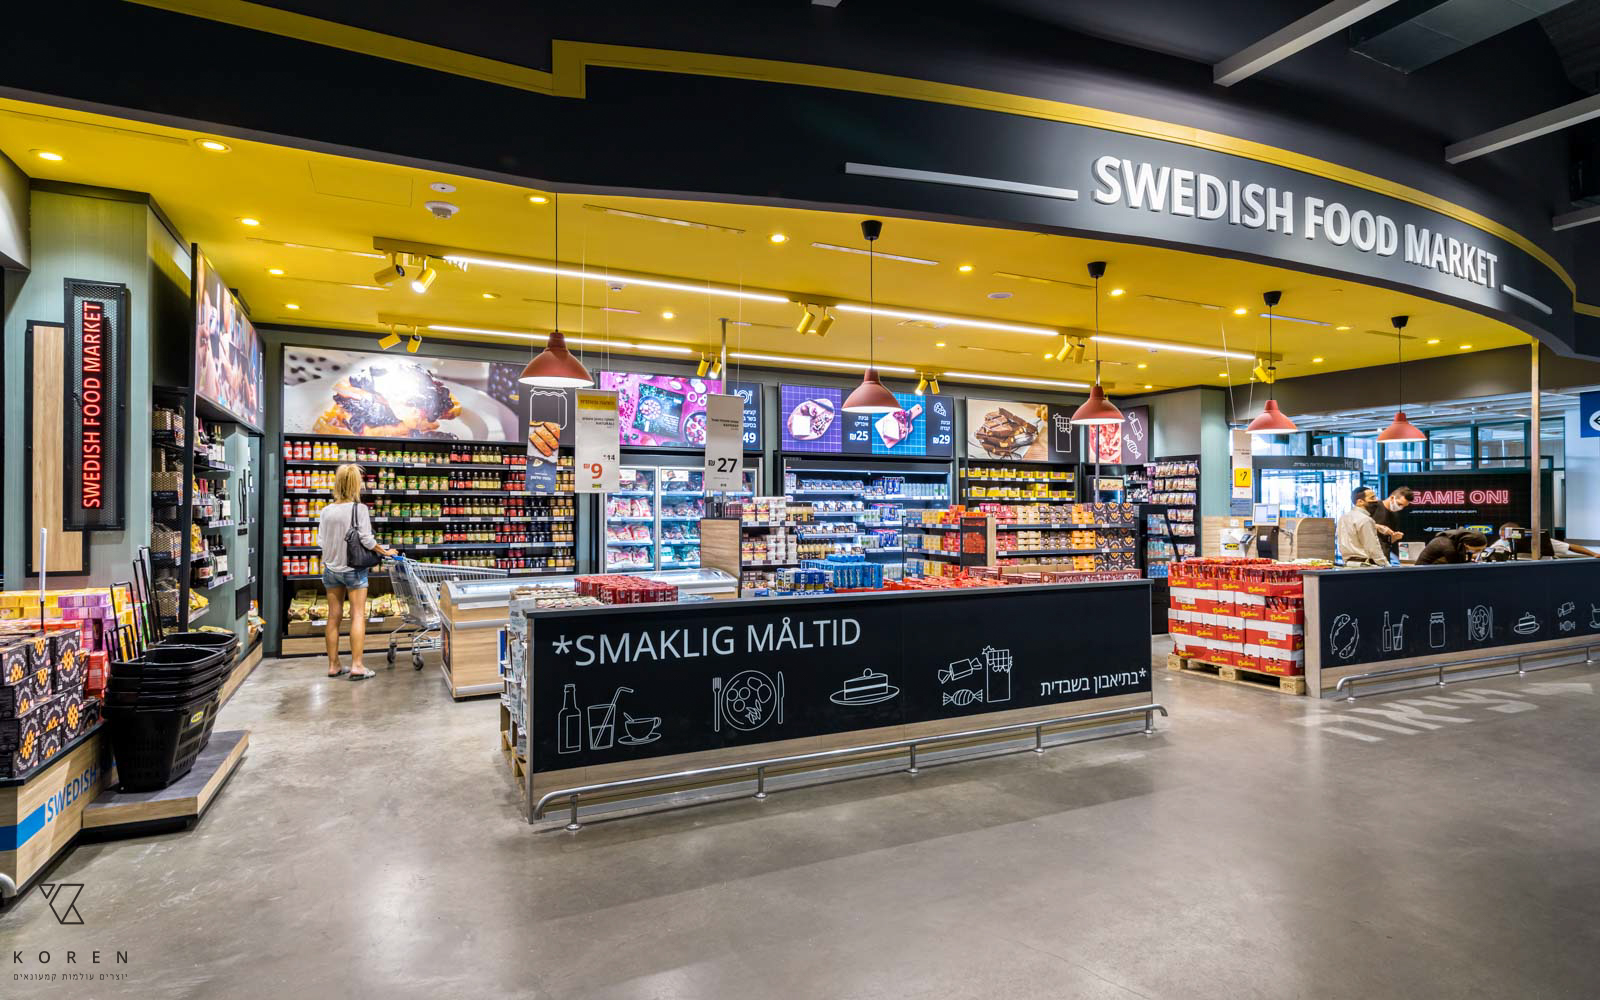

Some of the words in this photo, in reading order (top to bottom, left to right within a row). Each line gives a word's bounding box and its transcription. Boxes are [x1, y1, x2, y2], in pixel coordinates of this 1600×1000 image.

[1092, 154, 1294, 235] SWEDISH
[1304, 196, 1399, 258] FOOD
[1403, 223, 1498, 289] MARKET
[83, 302, 102, 372] MARKET
[83, 377, 102, 426] FOOD
[83, 431, 102, 508] SWEDISH
[1409, 490, 1465, 505] GAME
[1469, 490, 1509, 505] ON!
[747, 616, 862, 653] MÅLTID
[1040, 679, 1090, 697] בשבדית
[47, 767, 97, 823] SWEDISH
